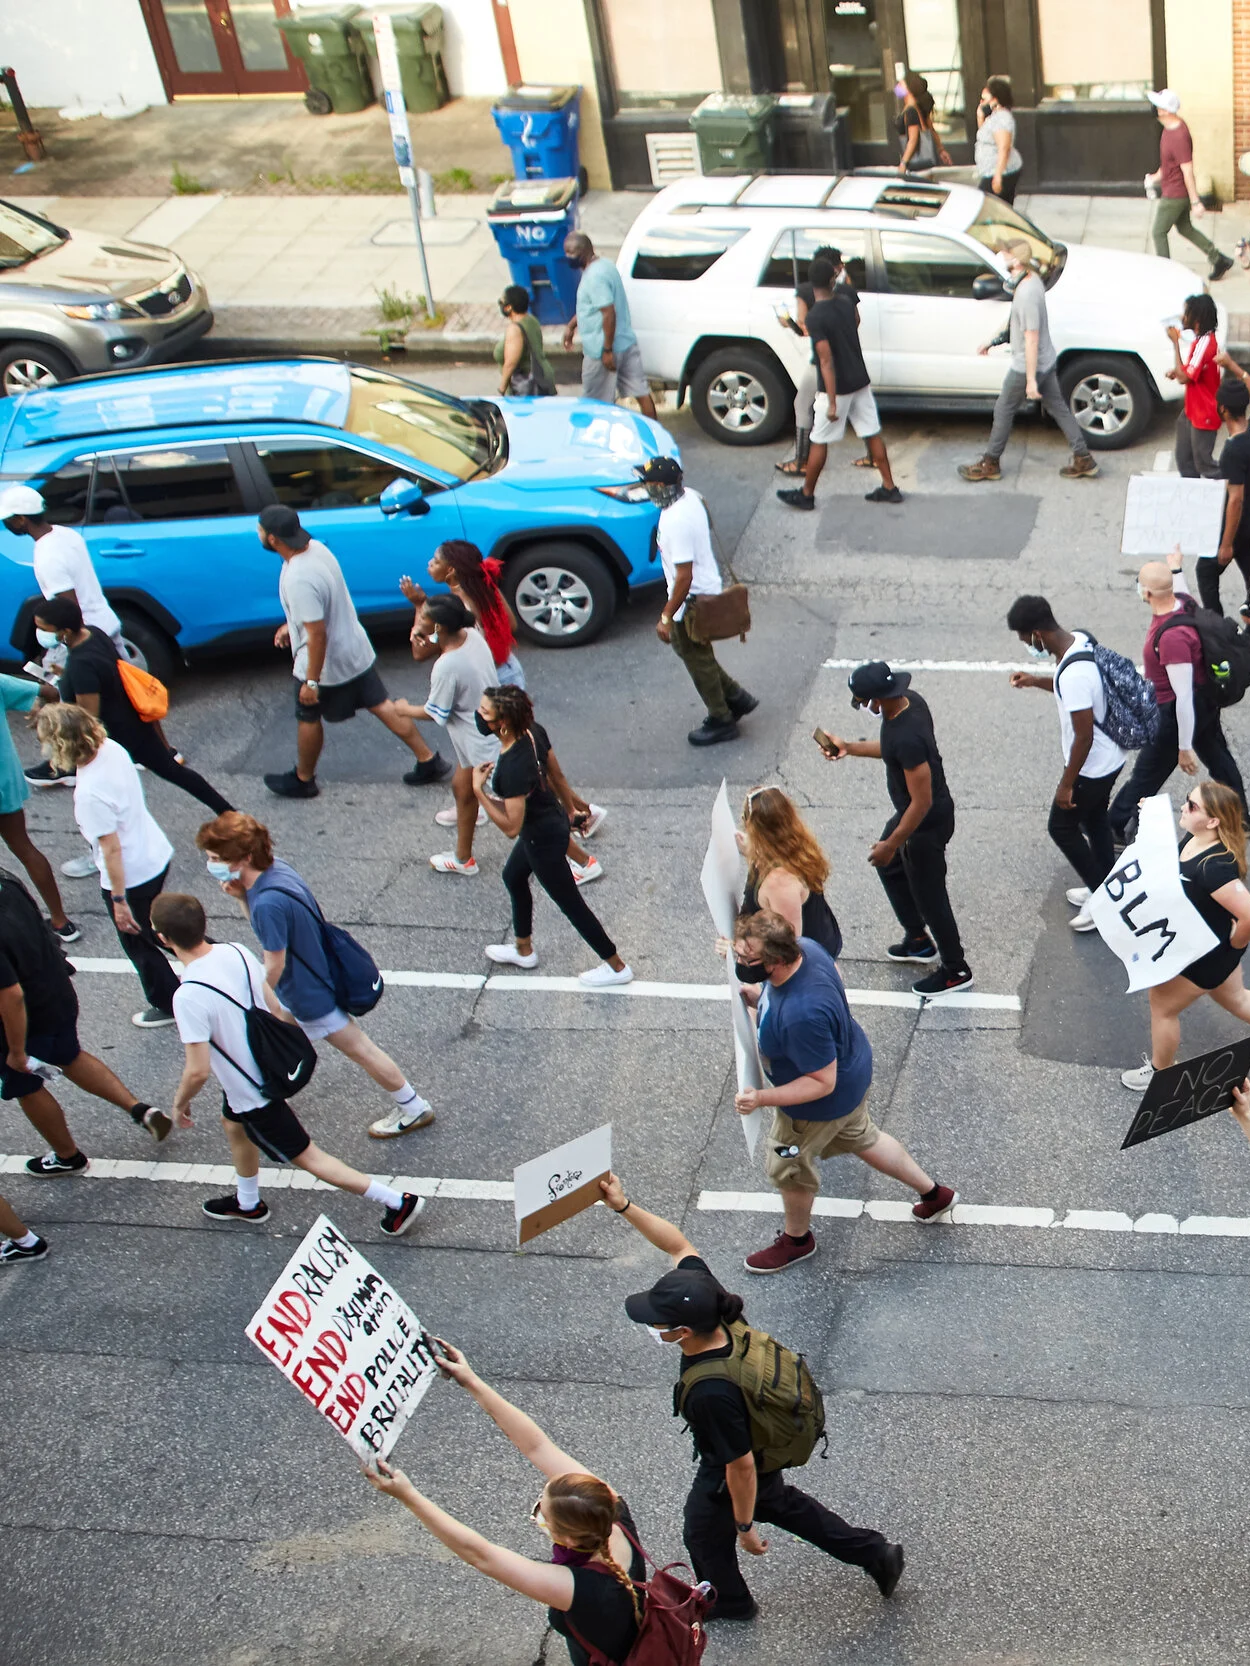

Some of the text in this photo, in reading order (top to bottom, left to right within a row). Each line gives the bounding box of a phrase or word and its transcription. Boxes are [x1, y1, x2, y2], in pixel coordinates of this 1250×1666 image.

[1104, 859, 1177, 962] BLM
[1126, 1076, 1241, 1145] PEACE
[1173, 1050, 1235, 1097] NO
[254, 1226, 352, 1367] END RACISM
[292, 1330, 347, 1408] END
[324, 1317, 411, 1435] END POLICE
[360, 1331, 431, 1453] BRUTALITY
